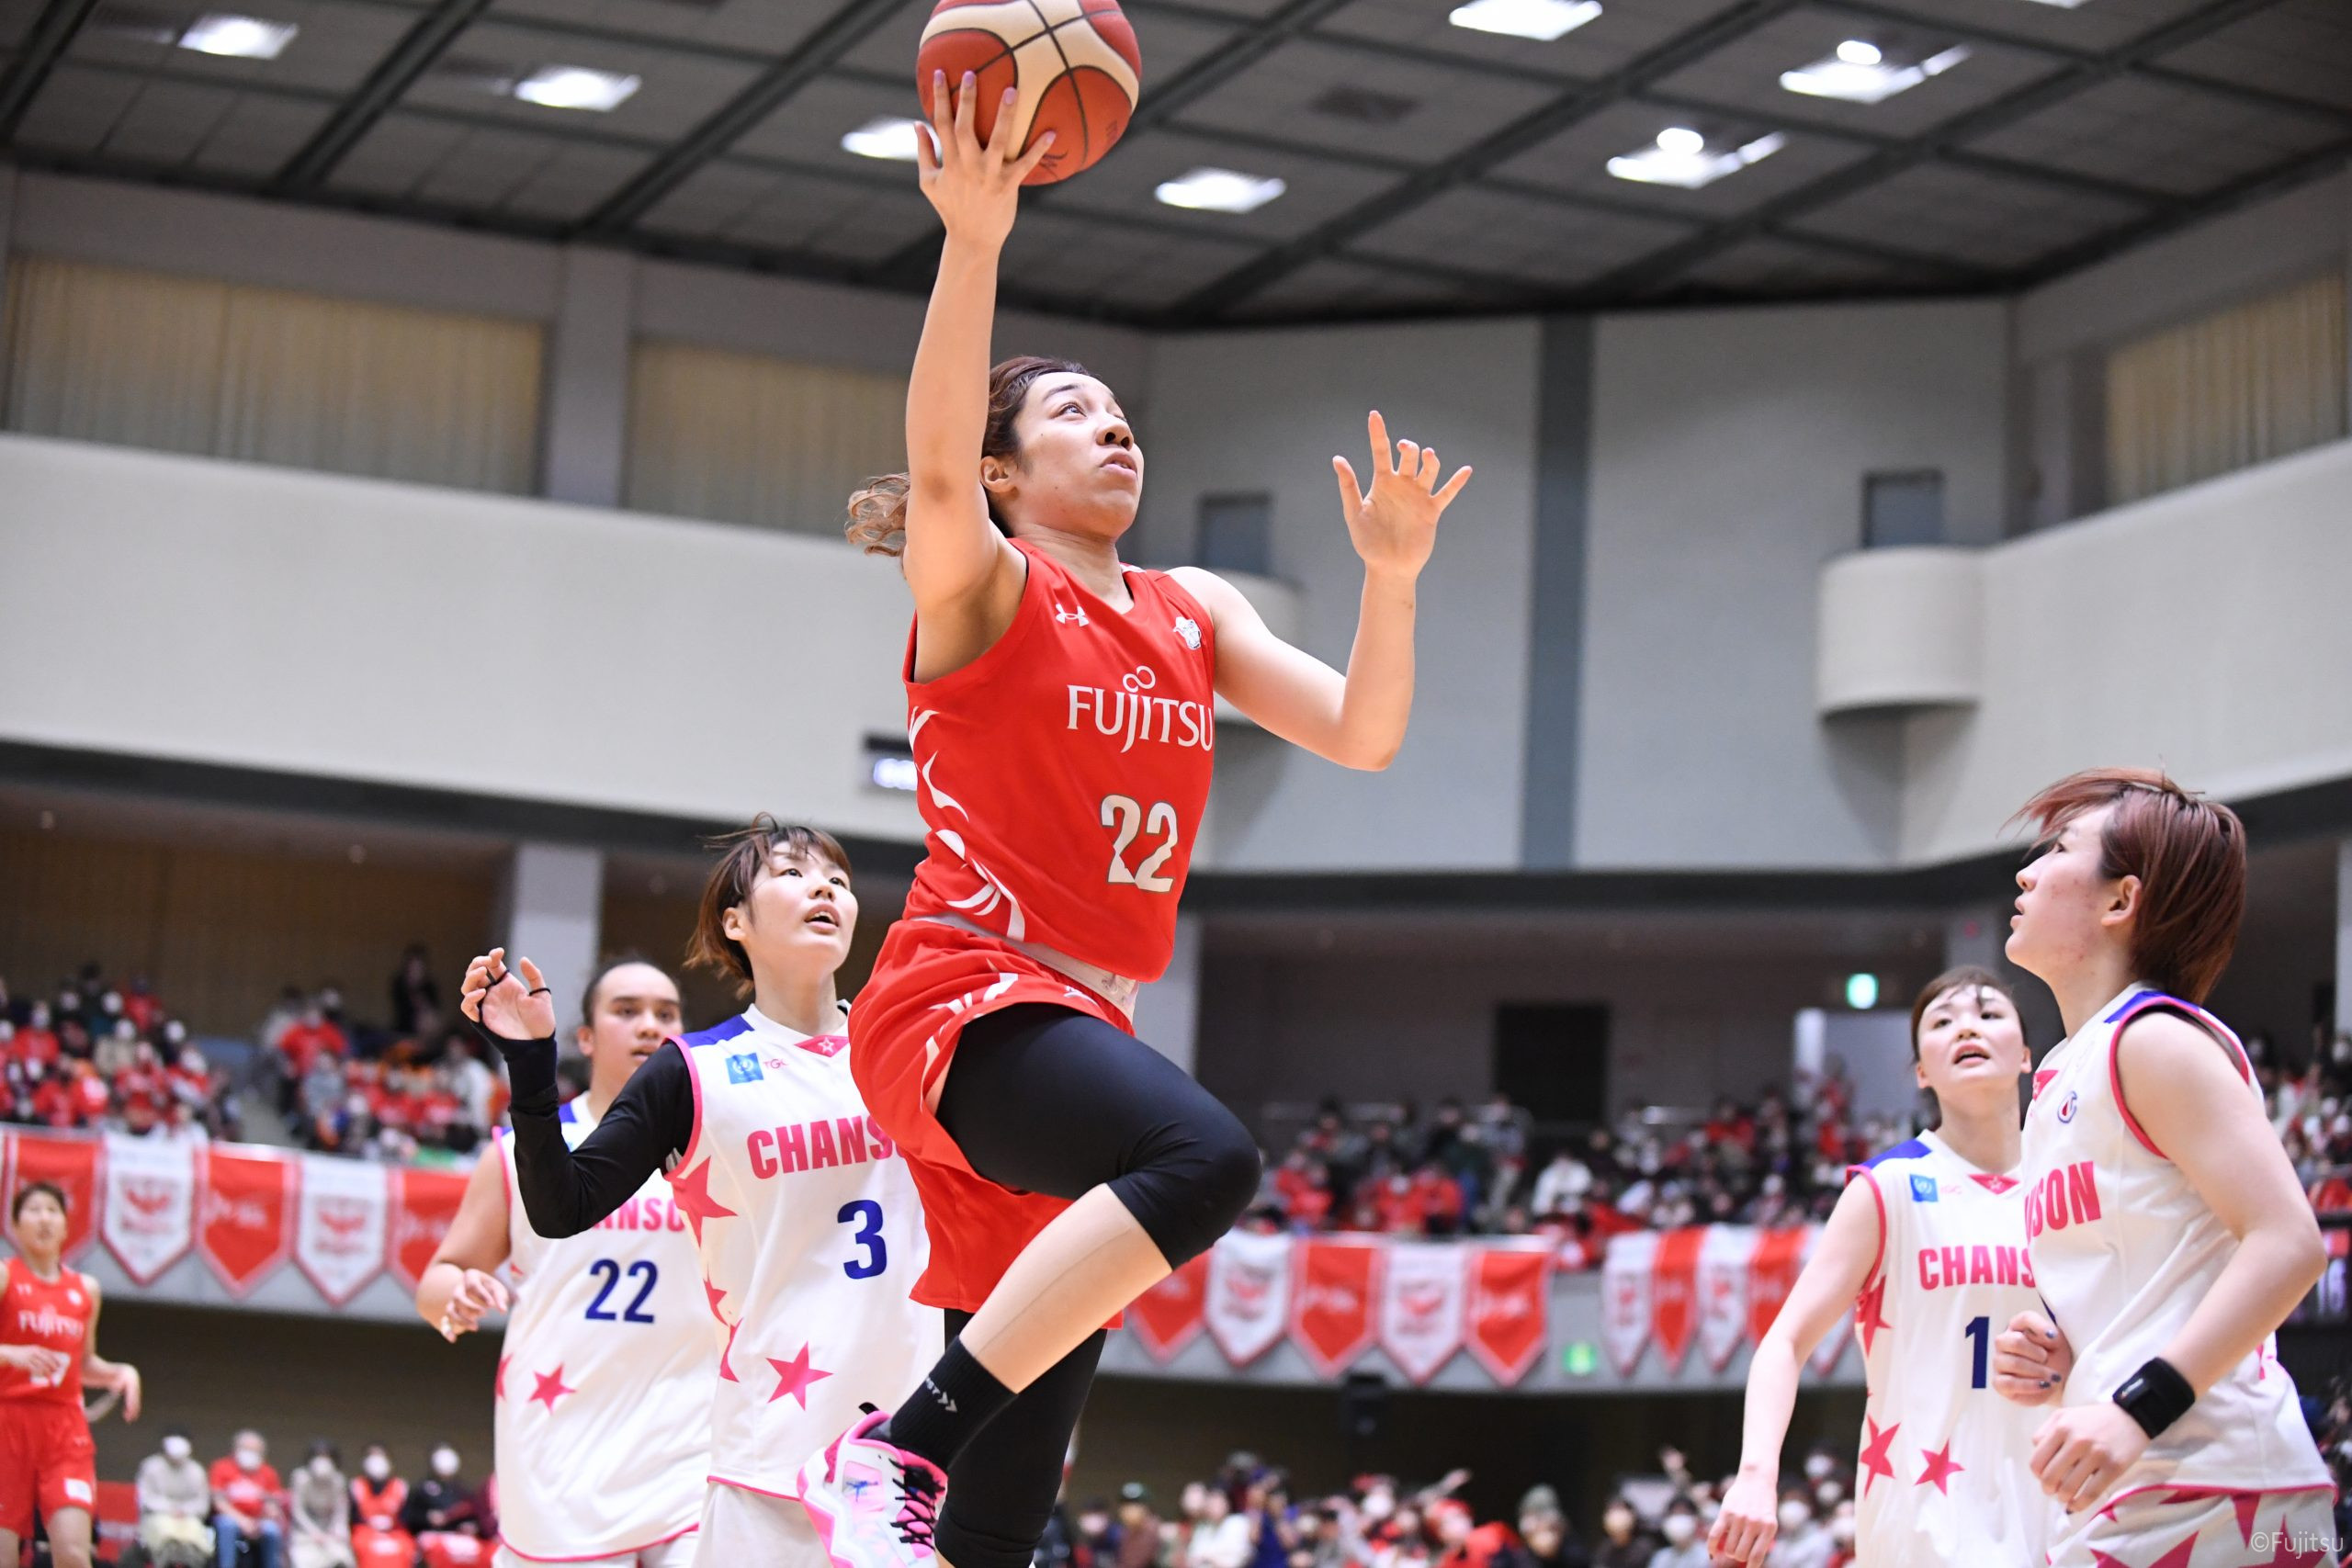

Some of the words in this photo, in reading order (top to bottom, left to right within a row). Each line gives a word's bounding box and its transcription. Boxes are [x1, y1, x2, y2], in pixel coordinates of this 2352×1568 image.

[1067, 683, 1214, 753] FUJITSU
[1101, 794, 1178, 893] 22
[747, 1115, 904, 1179] CHANS
[837, 1199, 888, 1280] 3
[585, 1258, 658, 1324] 22
